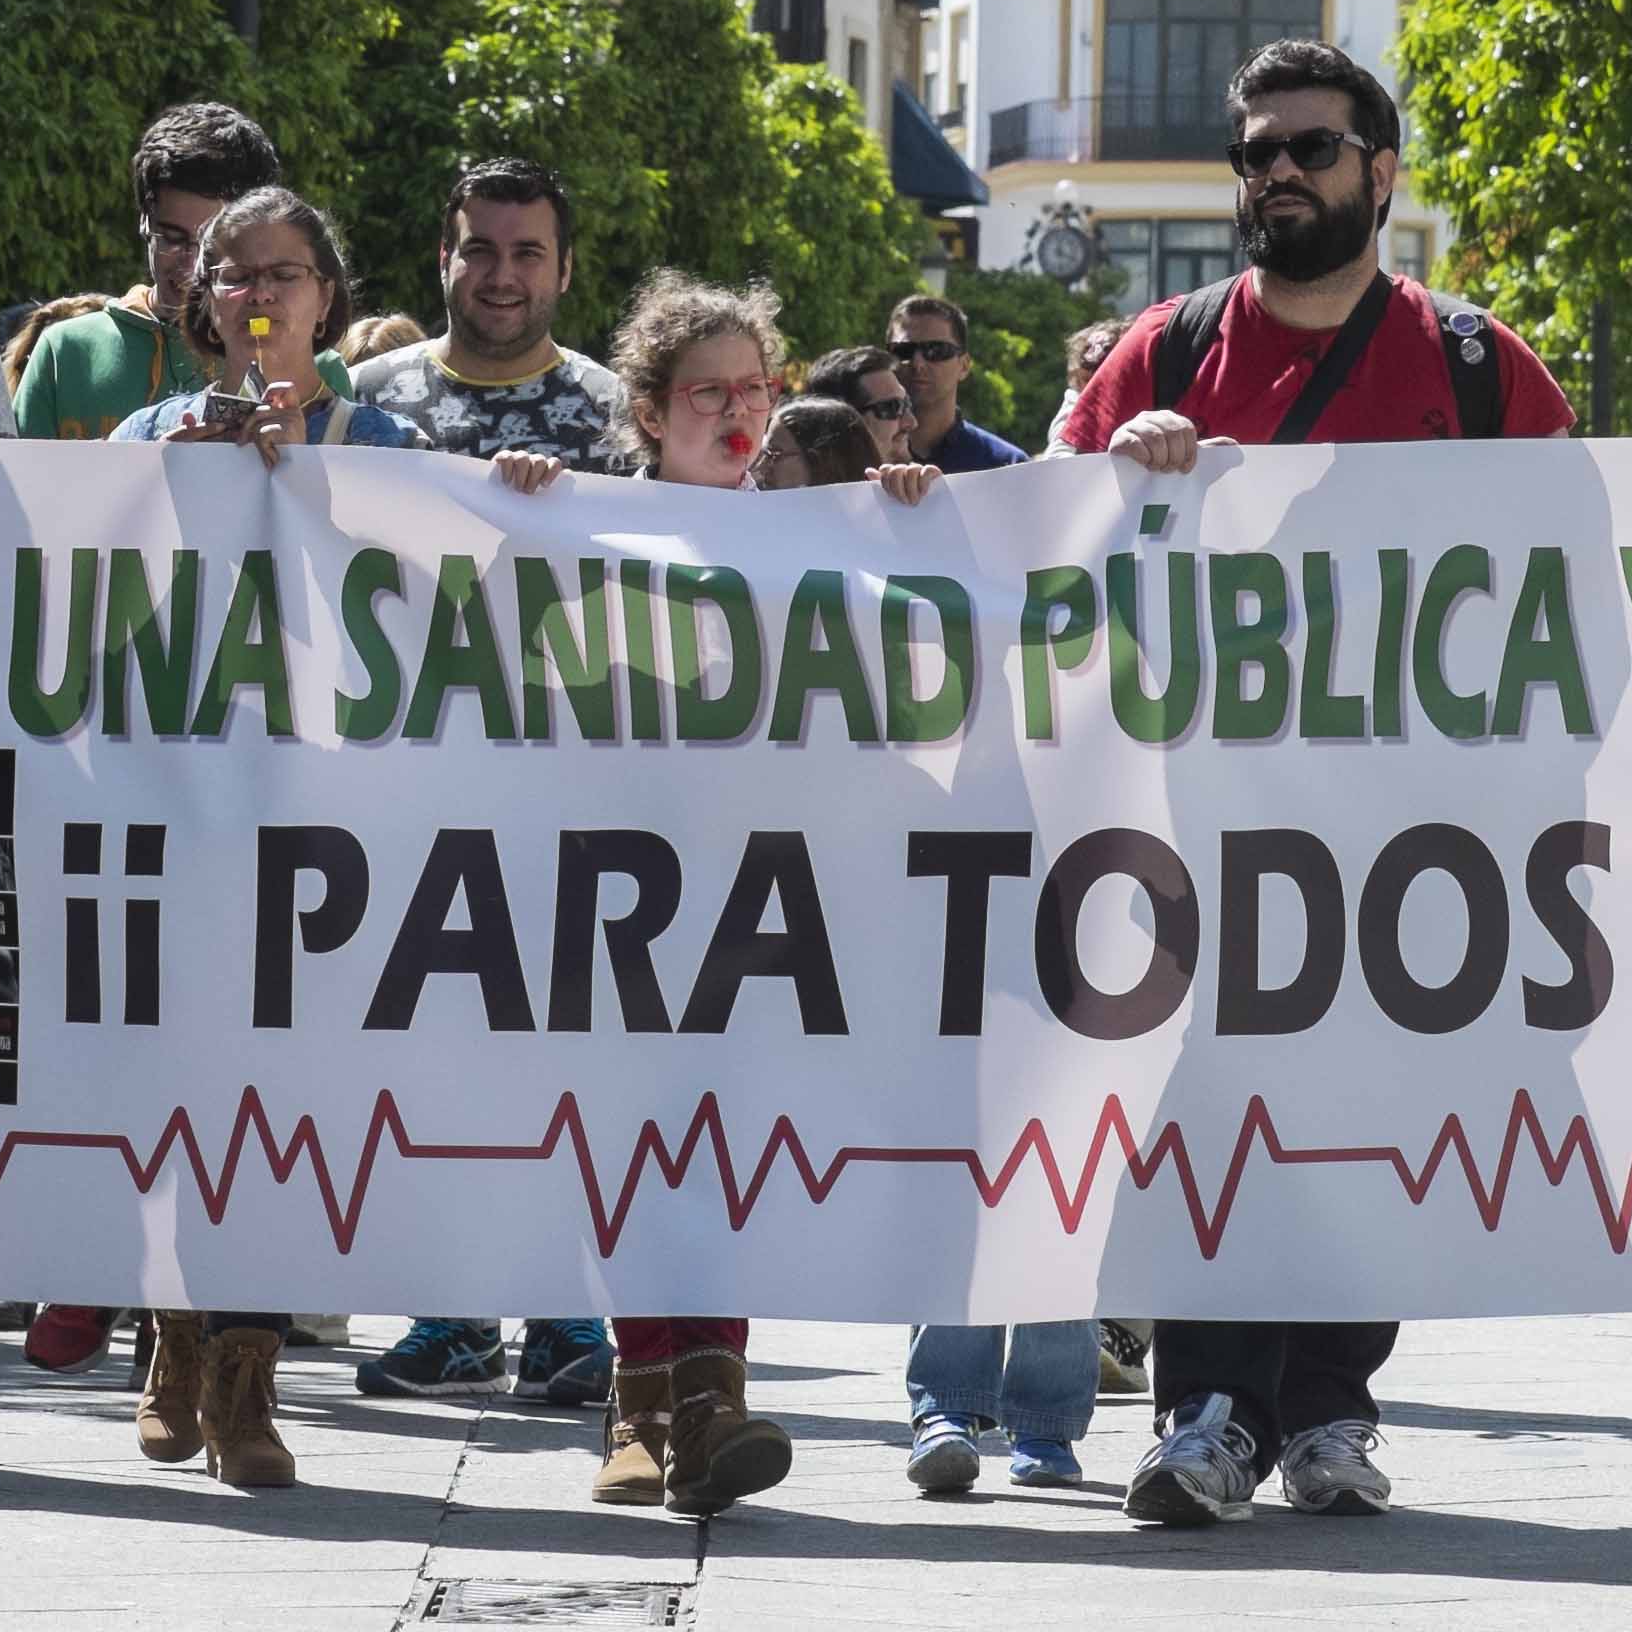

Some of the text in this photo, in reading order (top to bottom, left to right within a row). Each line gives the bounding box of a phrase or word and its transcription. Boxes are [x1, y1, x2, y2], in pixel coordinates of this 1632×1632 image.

[9, 550, 292, 737] UNA
[333, 547, 976, 742] SANIDAD
[1021, 503, 1596, 744] PÚBLICA
[252, 825, 850, 1036] PARA
[906, 820, 1614, 1041] TODOS
